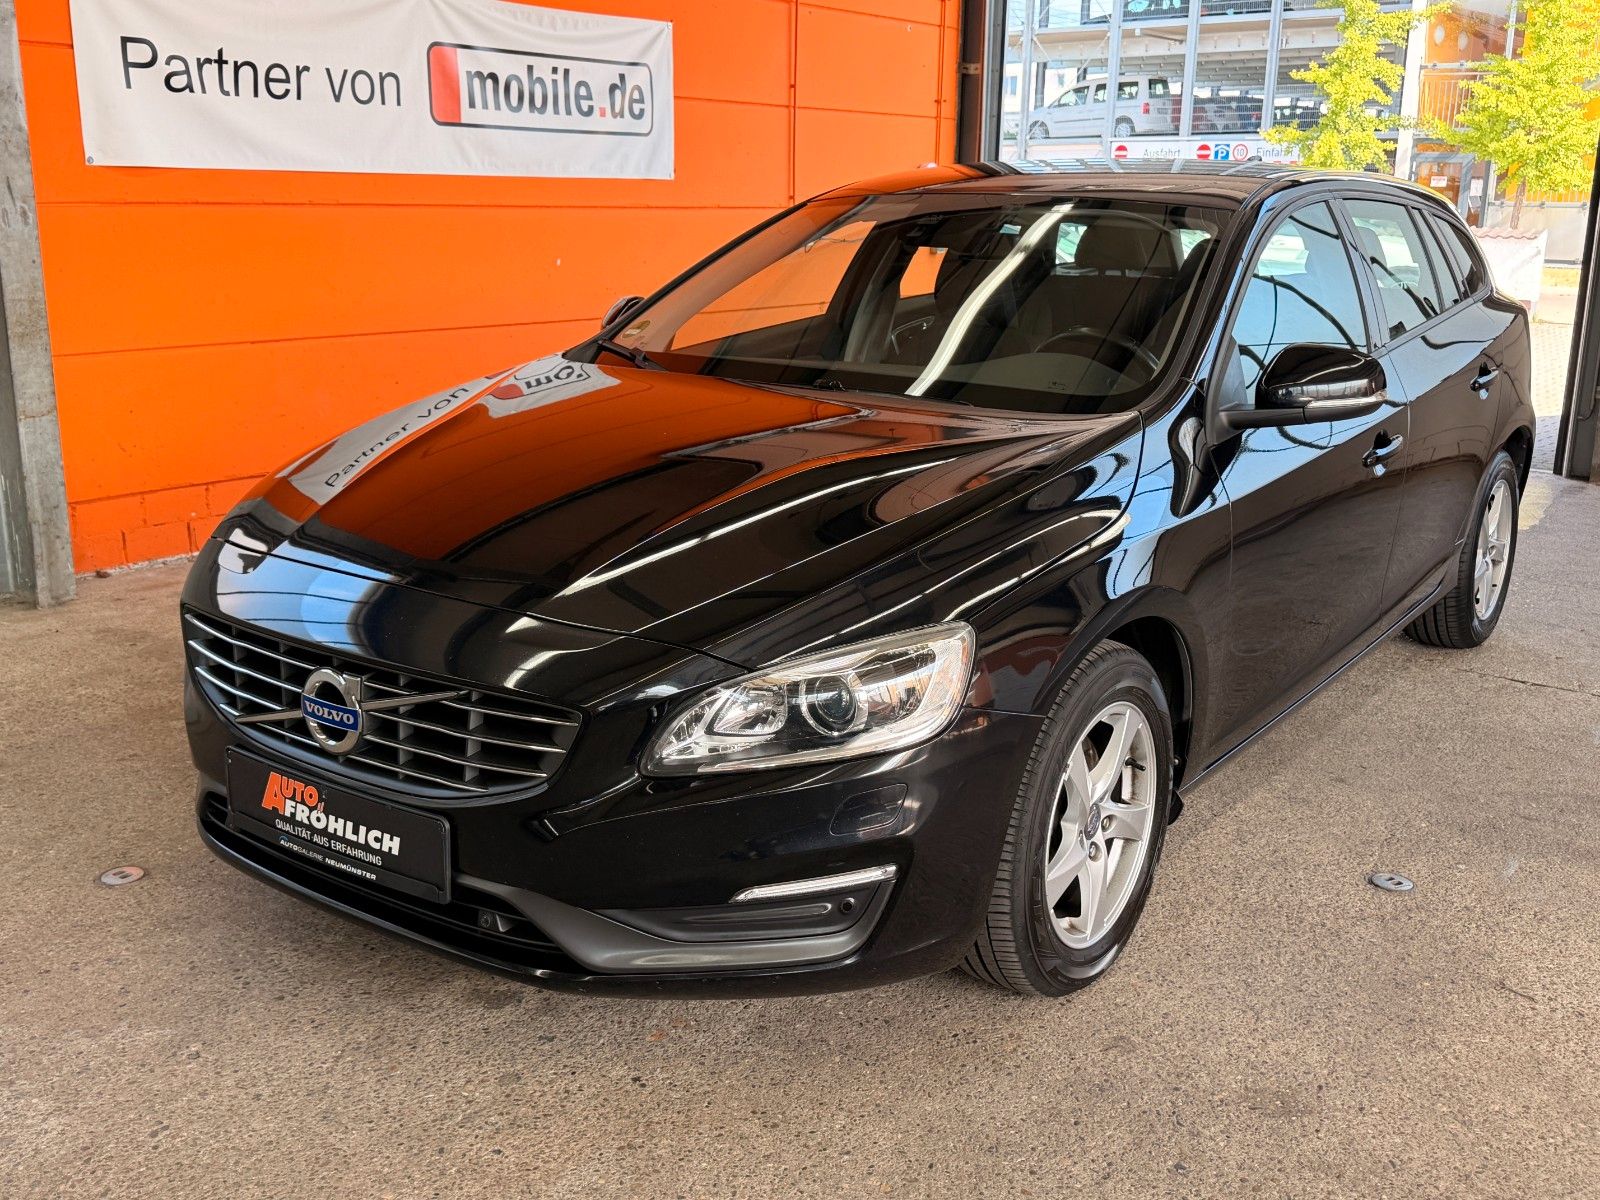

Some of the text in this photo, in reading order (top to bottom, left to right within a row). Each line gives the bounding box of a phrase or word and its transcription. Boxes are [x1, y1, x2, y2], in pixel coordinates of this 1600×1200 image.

[120, 36, 646, 120] Partner von mobile.de
[304, 700, 355, 725] VOLVO
[261, 771, 319, 815] AUTO
[275, 818, 383, 866] QUALITÄT AUS ERFAHRUNG
[284, 800, 401, 856] FRÖHLICH
[280, 839, 377, 880] AUTOGALERIE NEUMÜNSTER
